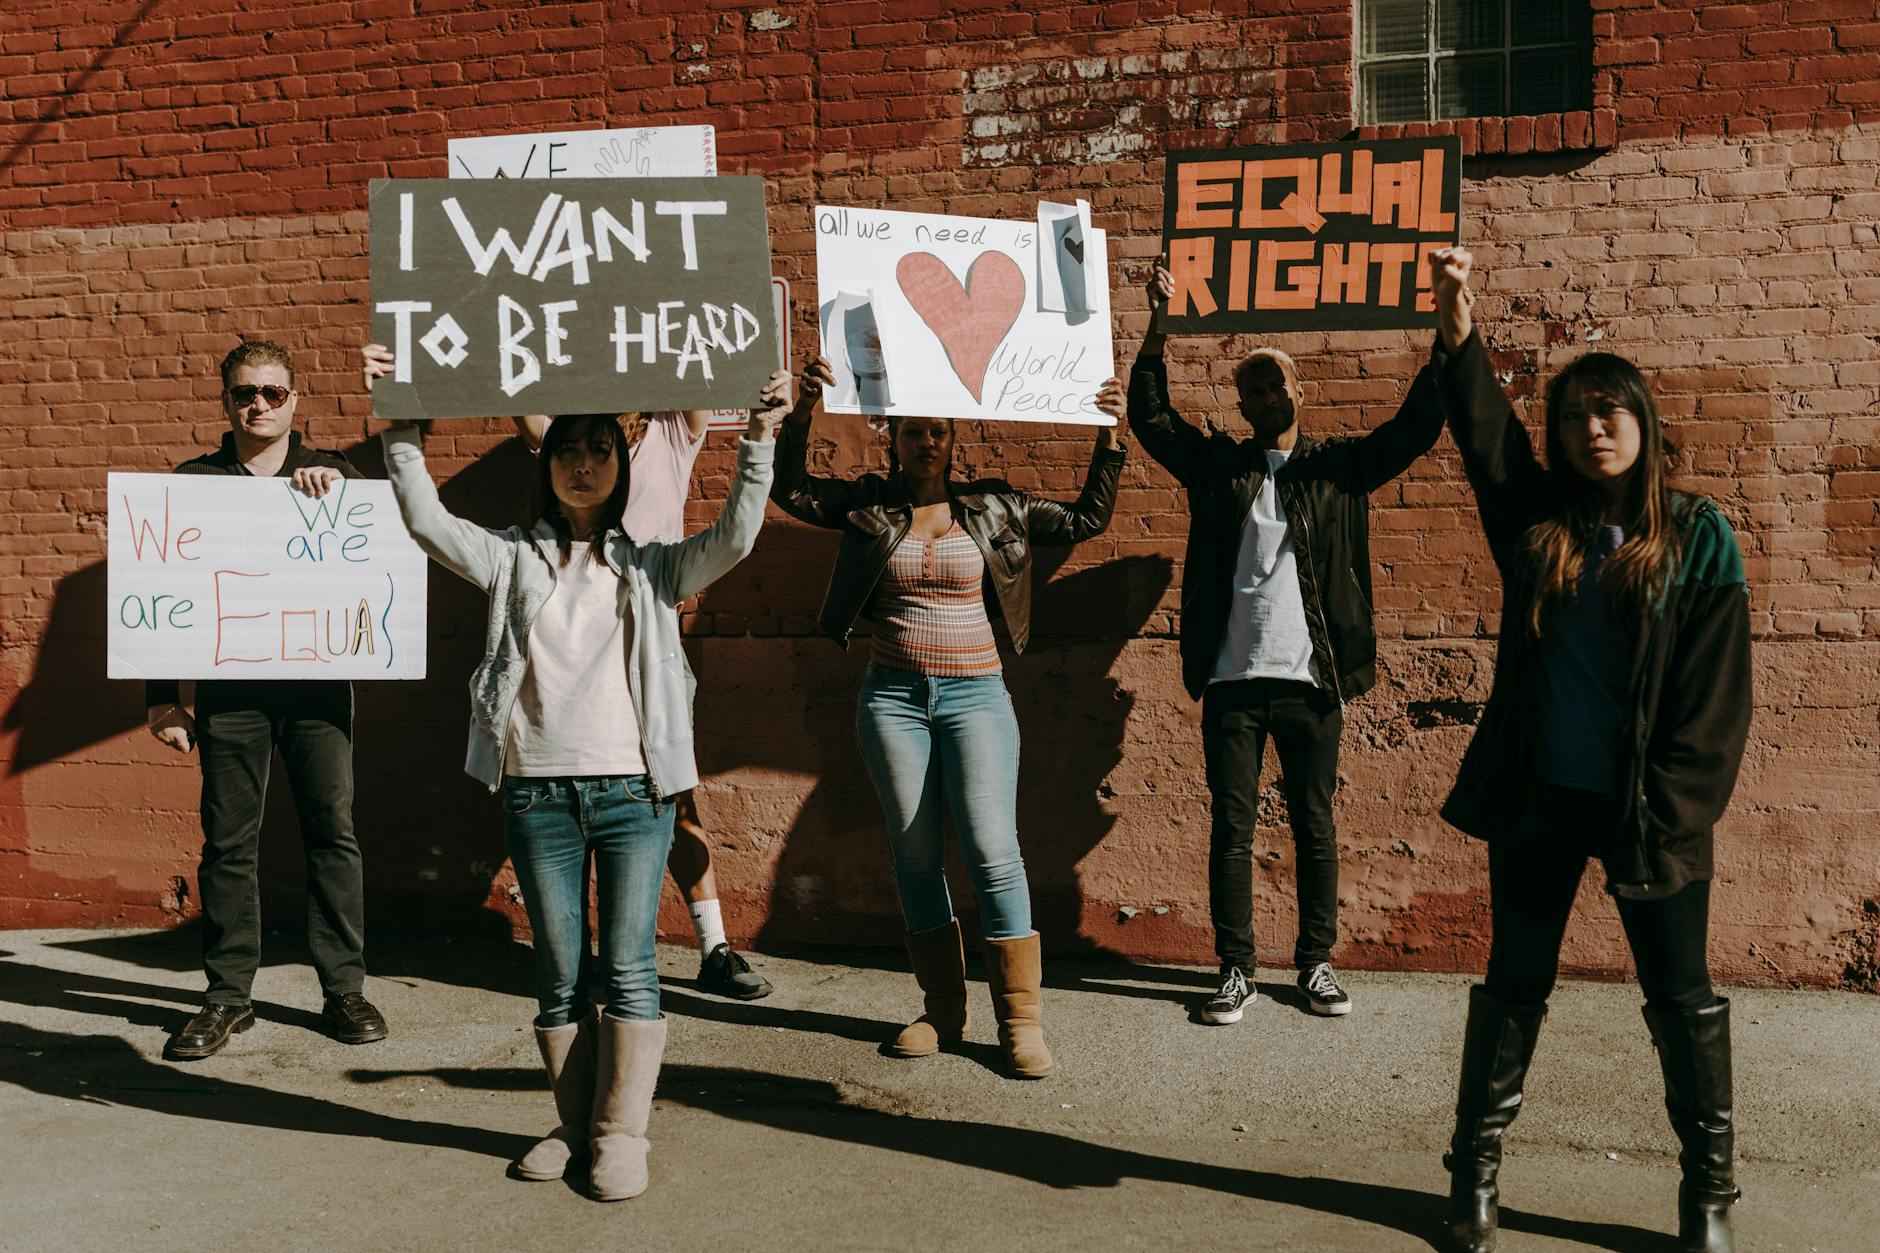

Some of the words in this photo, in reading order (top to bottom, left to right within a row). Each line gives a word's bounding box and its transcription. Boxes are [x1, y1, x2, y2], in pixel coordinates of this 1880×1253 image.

[1175, 148, 1456, 234] EQUAL
[400, 193, 415, 271] I
[441, 193, 728, 285] WANT
[819, 209, 849, 236] all
[856, 217, 893, 241] we
[915, 224, 987, 246] need
[1014, 230, 1033, 249] is
[376, 301, 470, 384] TO
[499, 294, 578, 398] BE
[609, 301, 761, 388] HEARD
[989, 340, 1093, 382] World
[994, 375, 1104, 415] Peace
[124, 485, 202, 563] We
[283, 479, 374, 532] We
[286, 530, 370, 562] are
[120, 594, 194, 630] are
